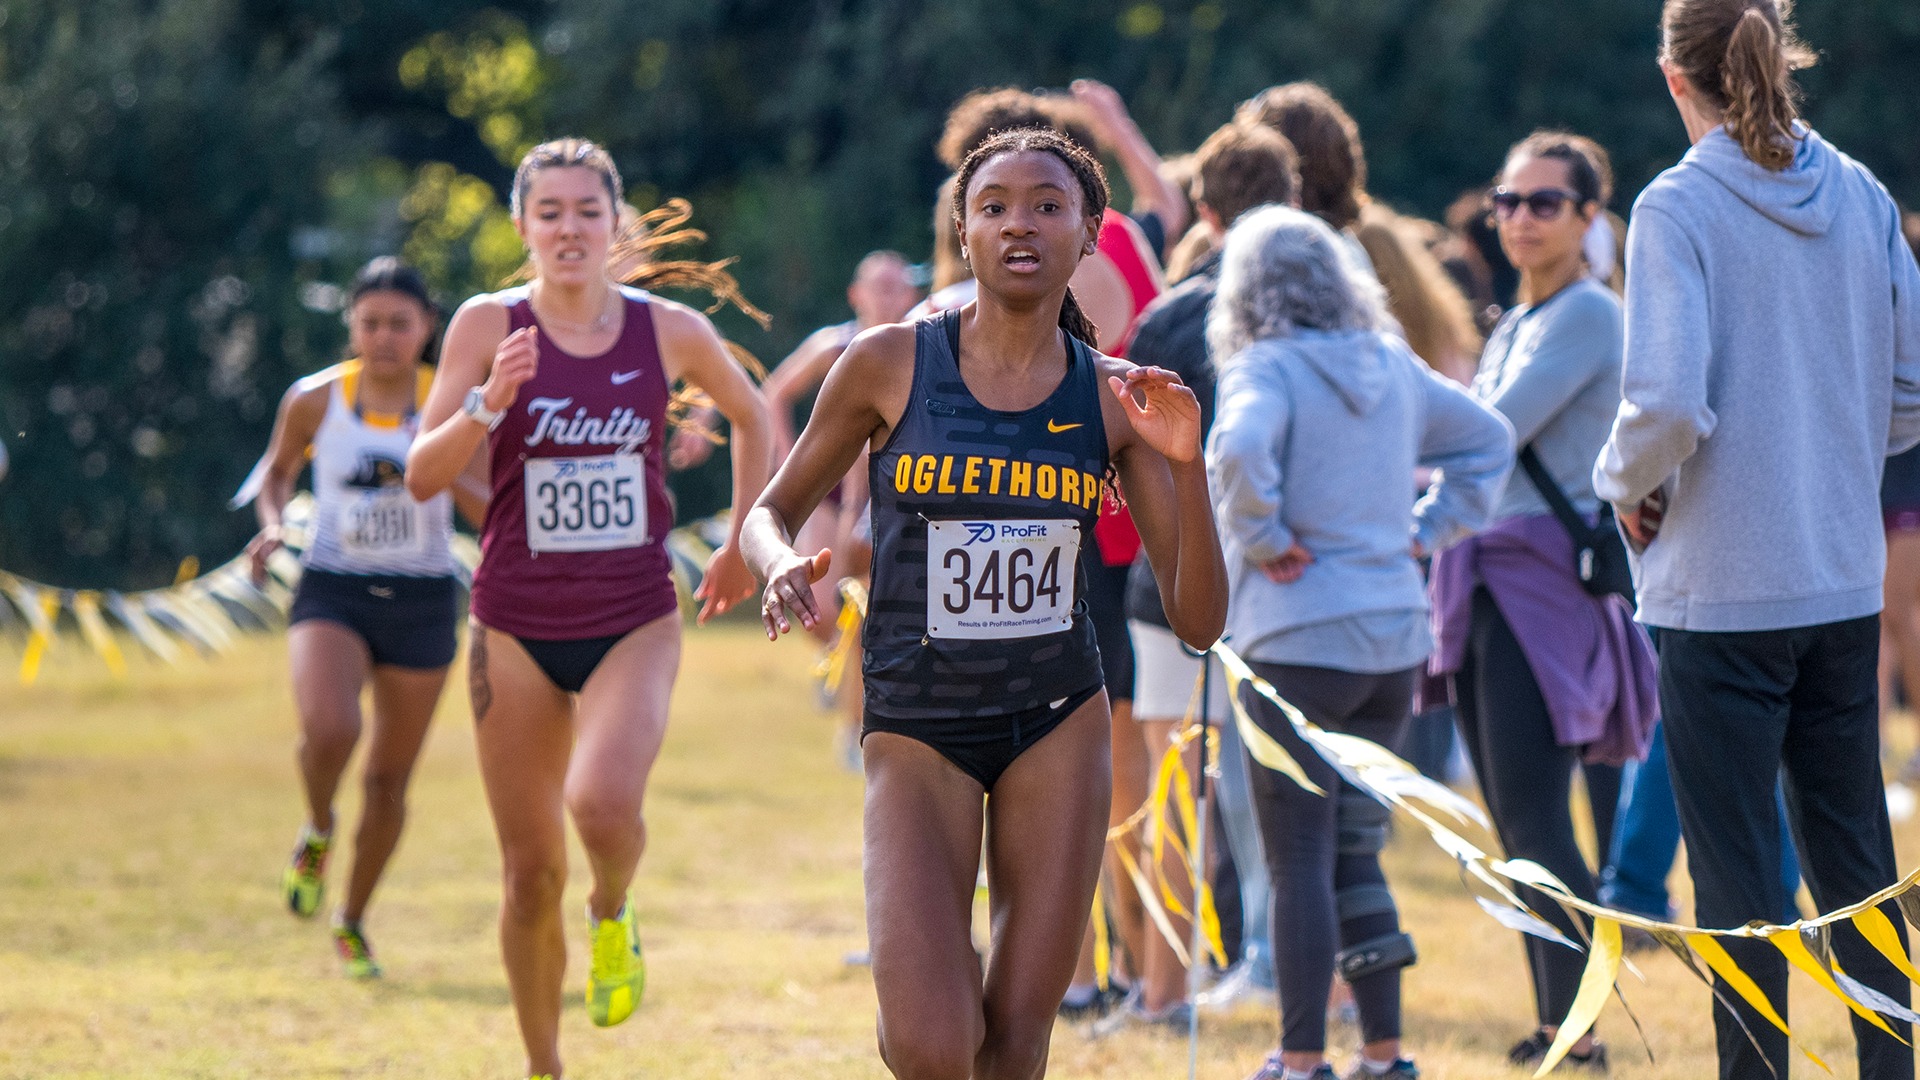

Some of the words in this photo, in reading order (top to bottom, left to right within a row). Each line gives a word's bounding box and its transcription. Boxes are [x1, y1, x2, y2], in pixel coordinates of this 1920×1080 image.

[524, 396, 652, 455] Trinity
[537, 476, 634, 531] 3365
[1001, 525, 1047, 537] ProFit
[943, 546, 1061, 614] 3464
[957, 620, 981, 628] Results
[989, 616, 1052, 628] ProFitRaceTiming.com
